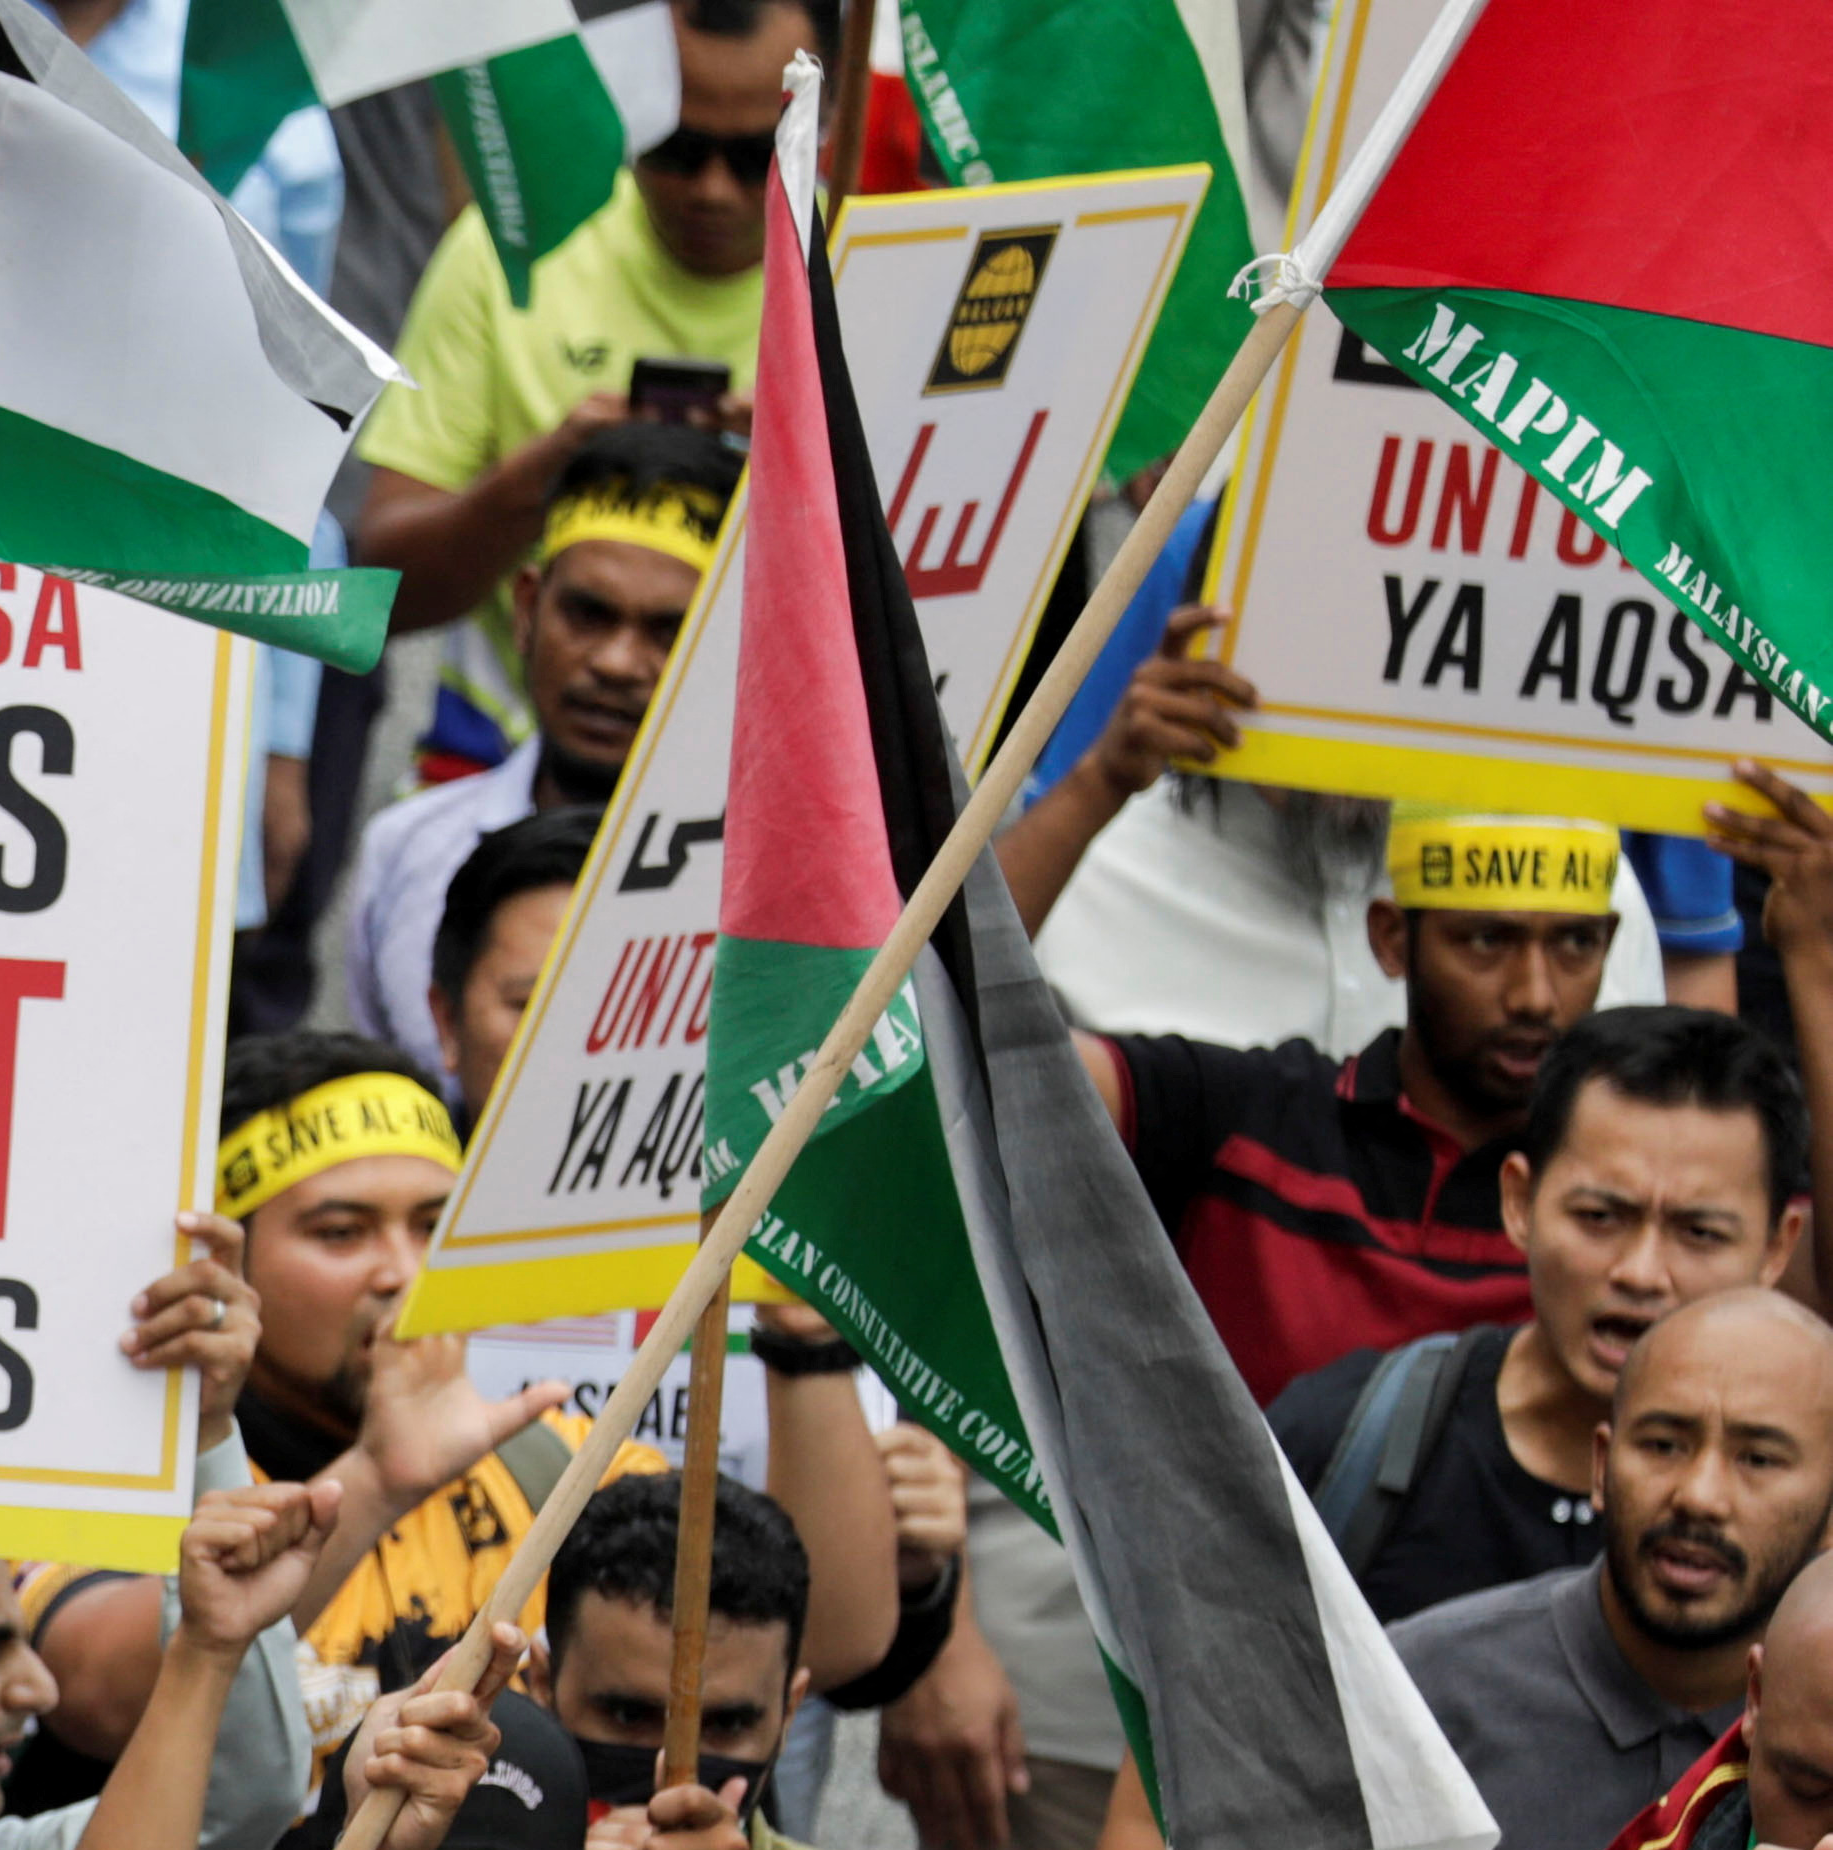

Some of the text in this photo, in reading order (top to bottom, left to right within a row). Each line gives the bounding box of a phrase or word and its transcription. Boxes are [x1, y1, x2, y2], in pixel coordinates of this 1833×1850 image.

[1402, 302, 1831, 723] MAPIM MALAYSIAN
[1381, 573, 1485, 693] YA
[1465, 847, 1546, 888] SAVE
[265, 1104, 347, 1169] SAVE
[546, 1074, 635, 1197] YA
[818, 1262, 965, 1423] CONSULTATIVE
